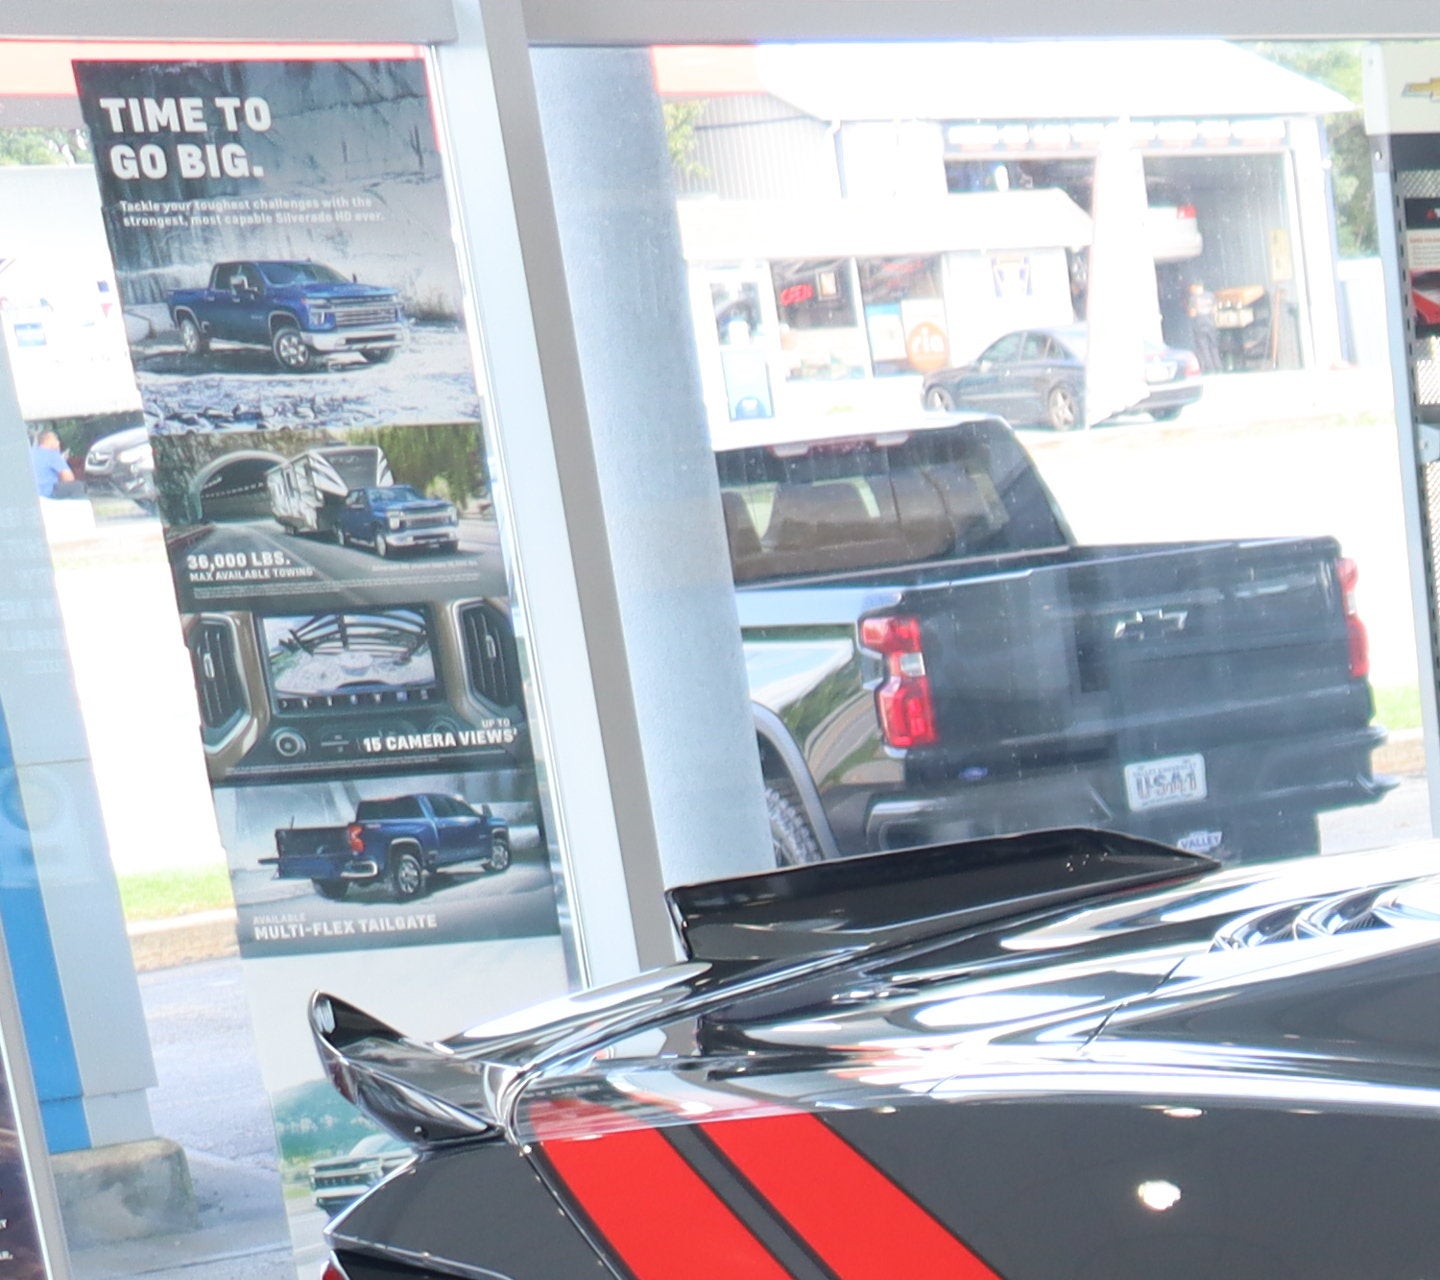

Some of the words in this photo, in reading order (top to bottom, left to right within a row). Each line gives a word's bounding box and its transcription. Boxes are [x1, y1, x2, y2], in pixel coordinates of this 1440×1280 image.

[99, 97, 208, 133] TIME
[215, 96, 272, 132] TO
[110, 143, 168, 180] GO
[177, 142, 264, 179] BIG.
[120, 200, 160, 212] Tackle
[163, 200, 193, 214] your
[194, 199, 250, 213] toughest
[252, 198, 320, 211] challenges
[321, 196, 349, 208] with
[351, 196, 373, 207] the
[123, 215, 189, 229] strongest,
[191, 216, 222, 226] most
[224, 213, 273, 227] capable
[275, 211, 333, 224] Silverado
[335, 210, 352, 221] HD
[186, 552, 247, 572] 36,000
[251, 551, 291, 567] LBS.
[190, 572, 213, 582] MAX
[215, 568, 271, 581] AVAILABLE
[482, 718, 496, 729] UP
[498, 717, 511, 728] TO
[363, 737, 382, 752] 15
[385, 733, 457, 752] CAMERA
[253, 912, 307, 925] AVAILABLE
[254, 920, 355, 941] MULTI-FLEX
[356, 914, 437, 933] TAILGATE
